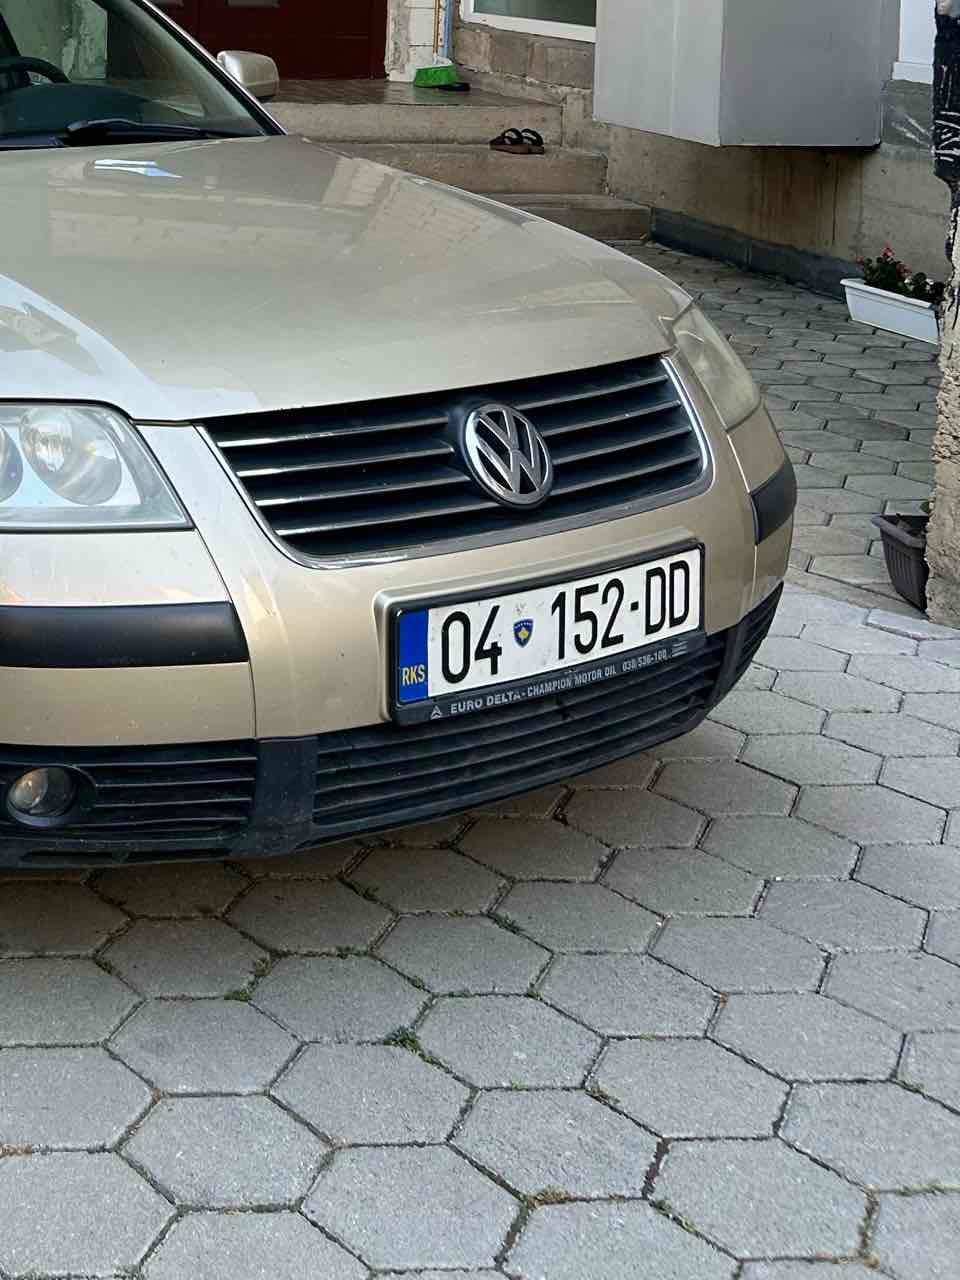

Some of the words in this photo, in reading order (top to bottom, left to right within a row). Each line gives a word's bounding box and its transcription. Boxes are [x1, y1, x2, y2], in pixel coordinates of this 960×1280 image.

[441, 605, 503, 684] 04
[401, 665, 426, 687] RKS
[450, 698, 483, 714] EURO
[574, 669, 602, 686] MOTOR
[604, 664, 617, 677] OIL
